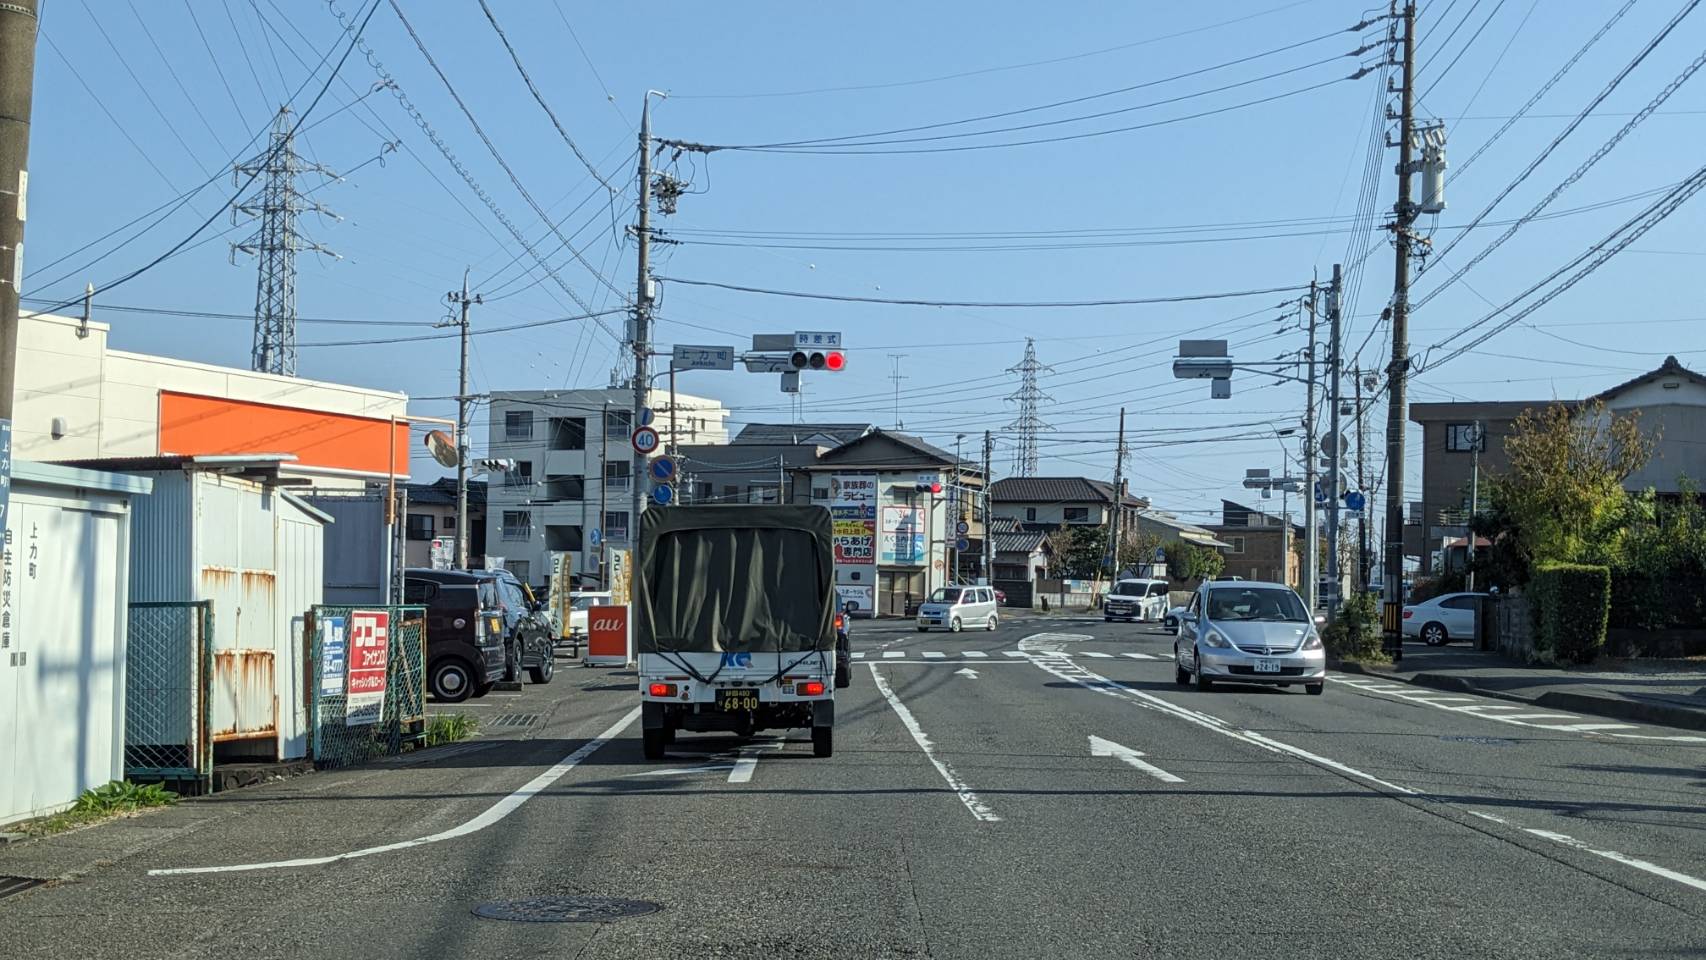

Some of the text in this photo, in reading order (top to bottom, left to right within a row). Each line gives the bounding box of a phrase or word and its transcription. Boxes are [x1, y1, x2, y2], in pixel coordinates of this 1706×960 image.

[799, 334, 836, 345] 時差式
[680, 351, 727, 361] 上力町
[638, 434, 653, 447] 40
[29, 522, 37, 580] 上力町
[1, 528, 13, 649] 自主防災倉庫
[593, 619, 623, 631] au
[724, 697, 758, 709] 68-00
